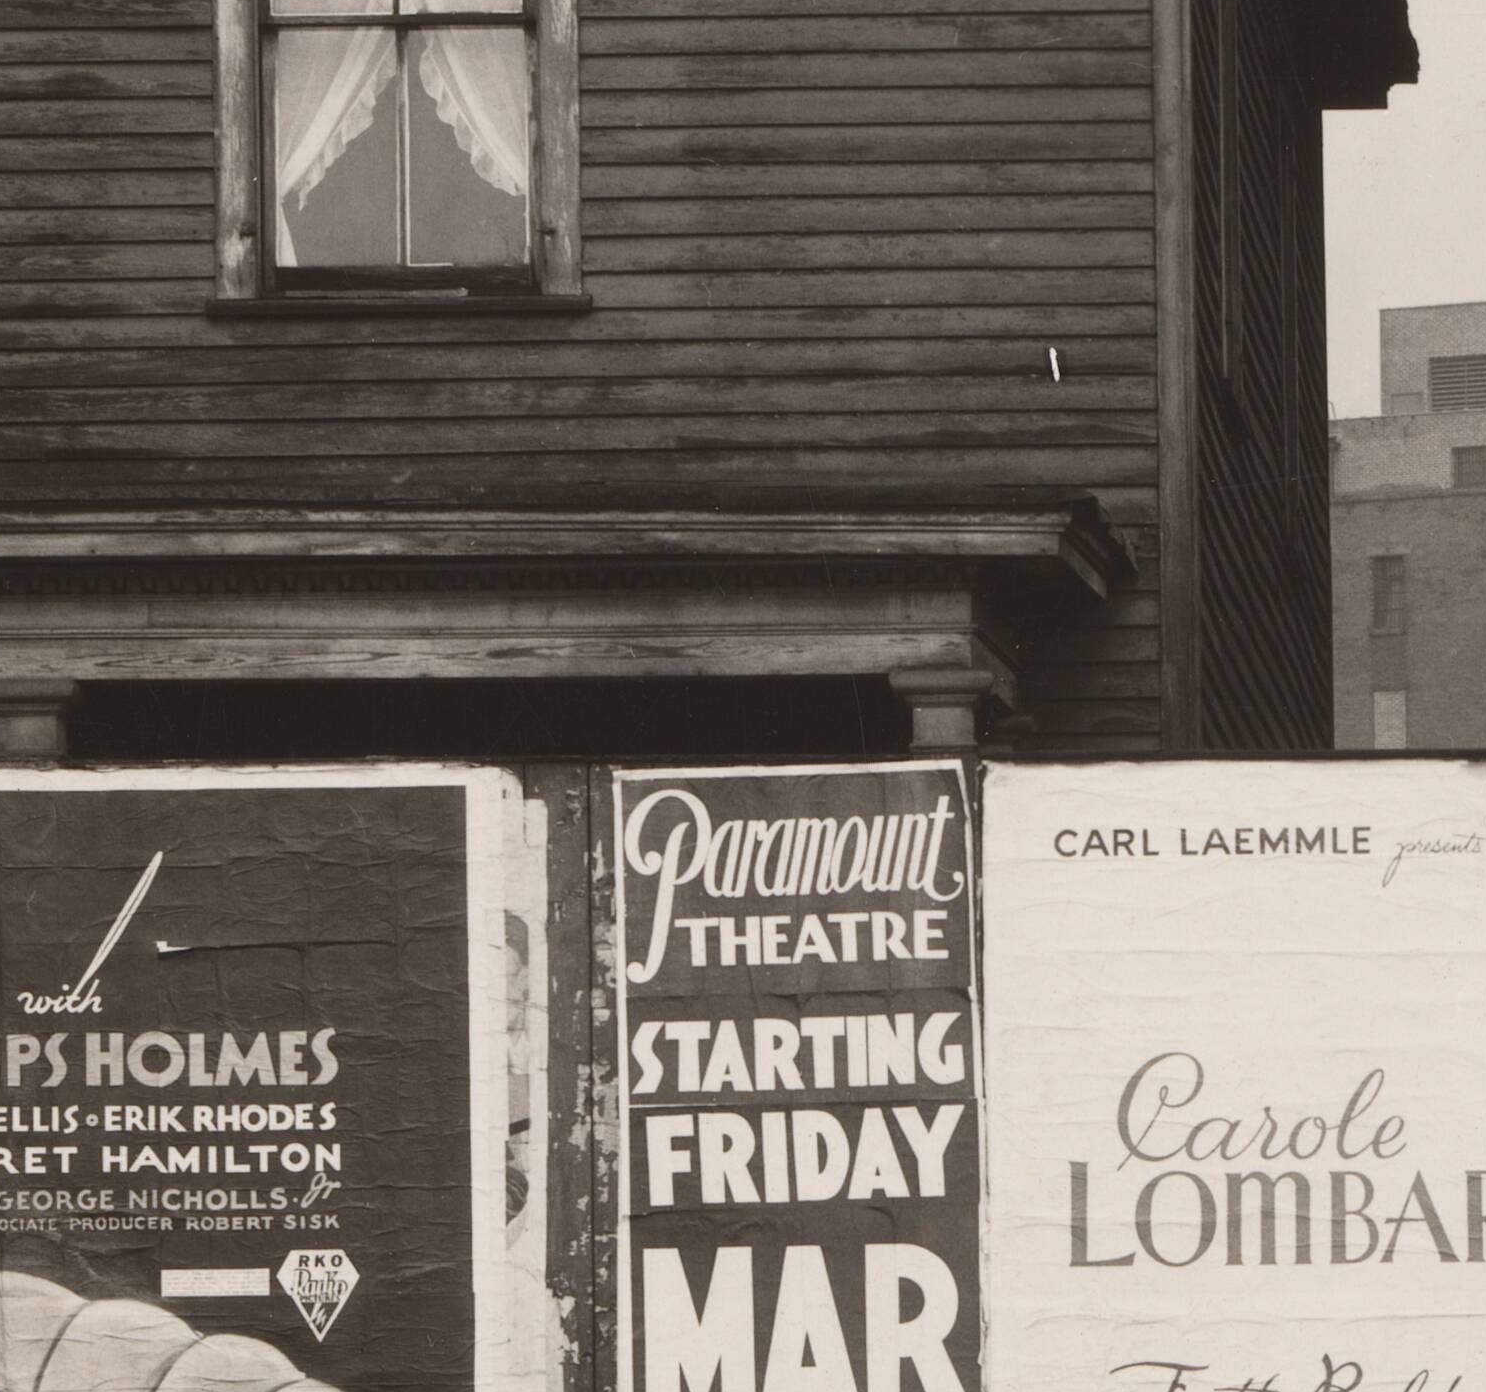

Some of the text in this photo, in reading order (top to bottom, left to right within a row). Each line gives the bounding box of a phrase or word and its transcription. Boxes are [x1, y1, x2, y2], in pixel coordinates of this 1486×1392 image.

[624, 789, 964, 983] Paramount
[1054, 826, 1483, 888] CARL LAEMMLE presents
[675, 910, 949, 966] THEATRE
[85, 1027, 339, 1087] HOLMES
[632, 1012, 966, 1094] STARTING
[104, 1105, 185, 1133] ERIK
[193, 1102, 336, 1132] RHODES
[1117, 1052, 1407, 1171] Carole
[102, 1143, 342, 1175] HAMILTON
[645, 1104, 965, 1207] FRIDAY
[69, 1215, 173, 1232] PRODUCER
[186, 1215, 272, 1231] ROBERT
[283, 1213, 340, 1230] SISK
[298, 1254, 343, 1268] RKO
